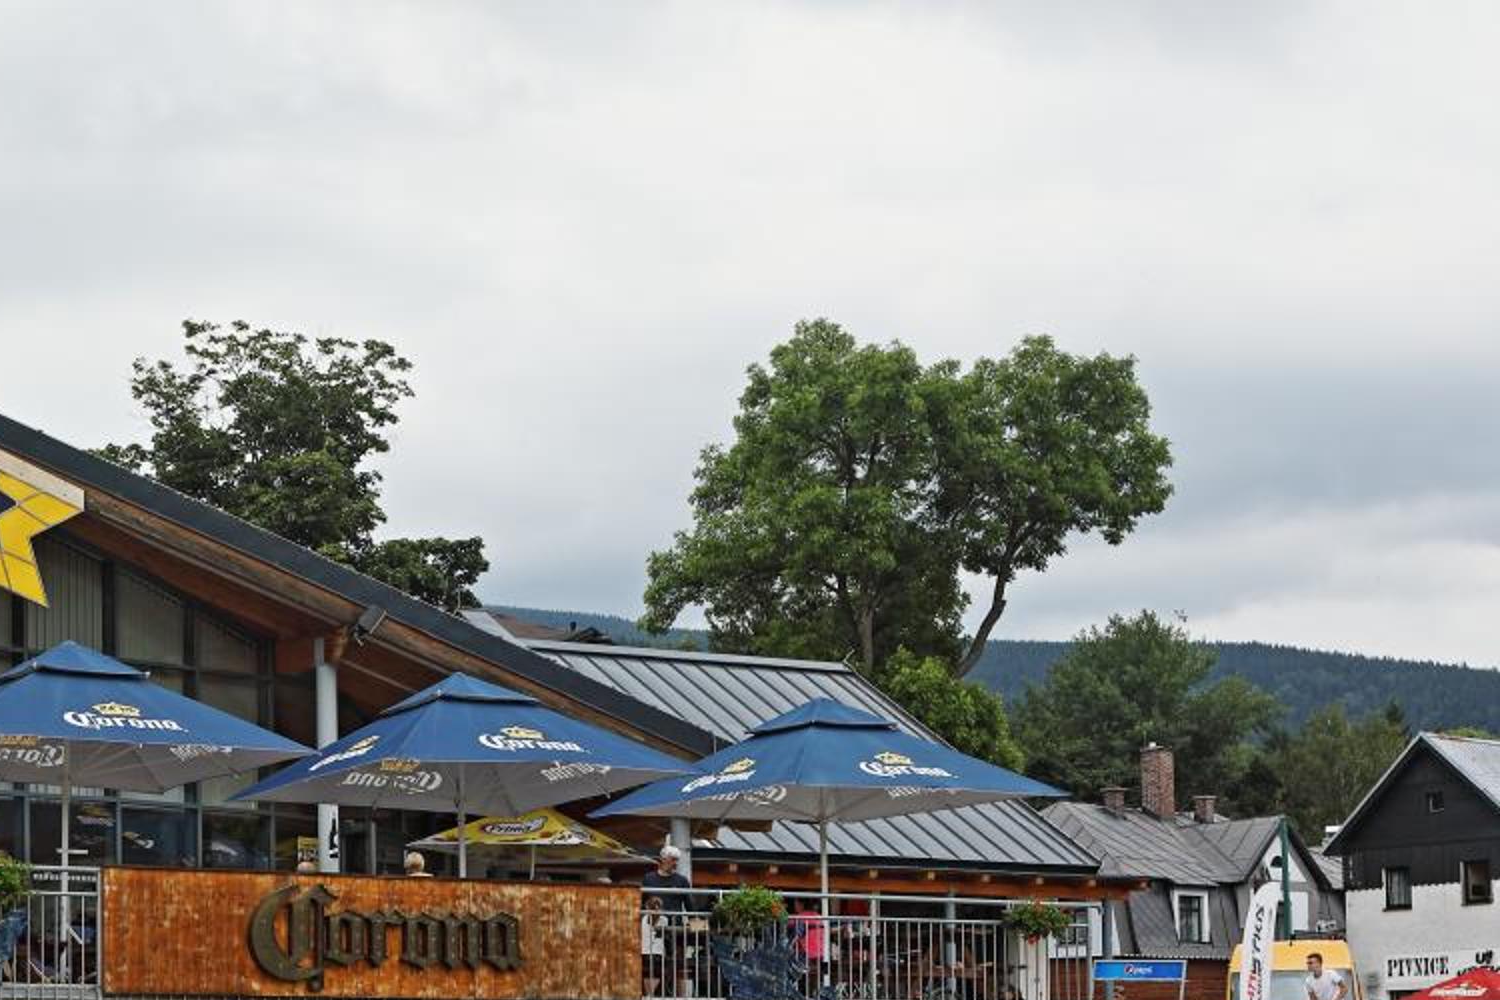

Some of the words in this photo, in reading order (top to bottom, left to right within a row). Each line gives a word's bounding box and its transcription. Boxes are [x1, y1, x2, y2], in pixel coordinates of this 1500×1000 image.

[63, 711, 182, 732] Corona
[478, 734, 585, 753] Corona
[247, 883, 524, 992] Corona
